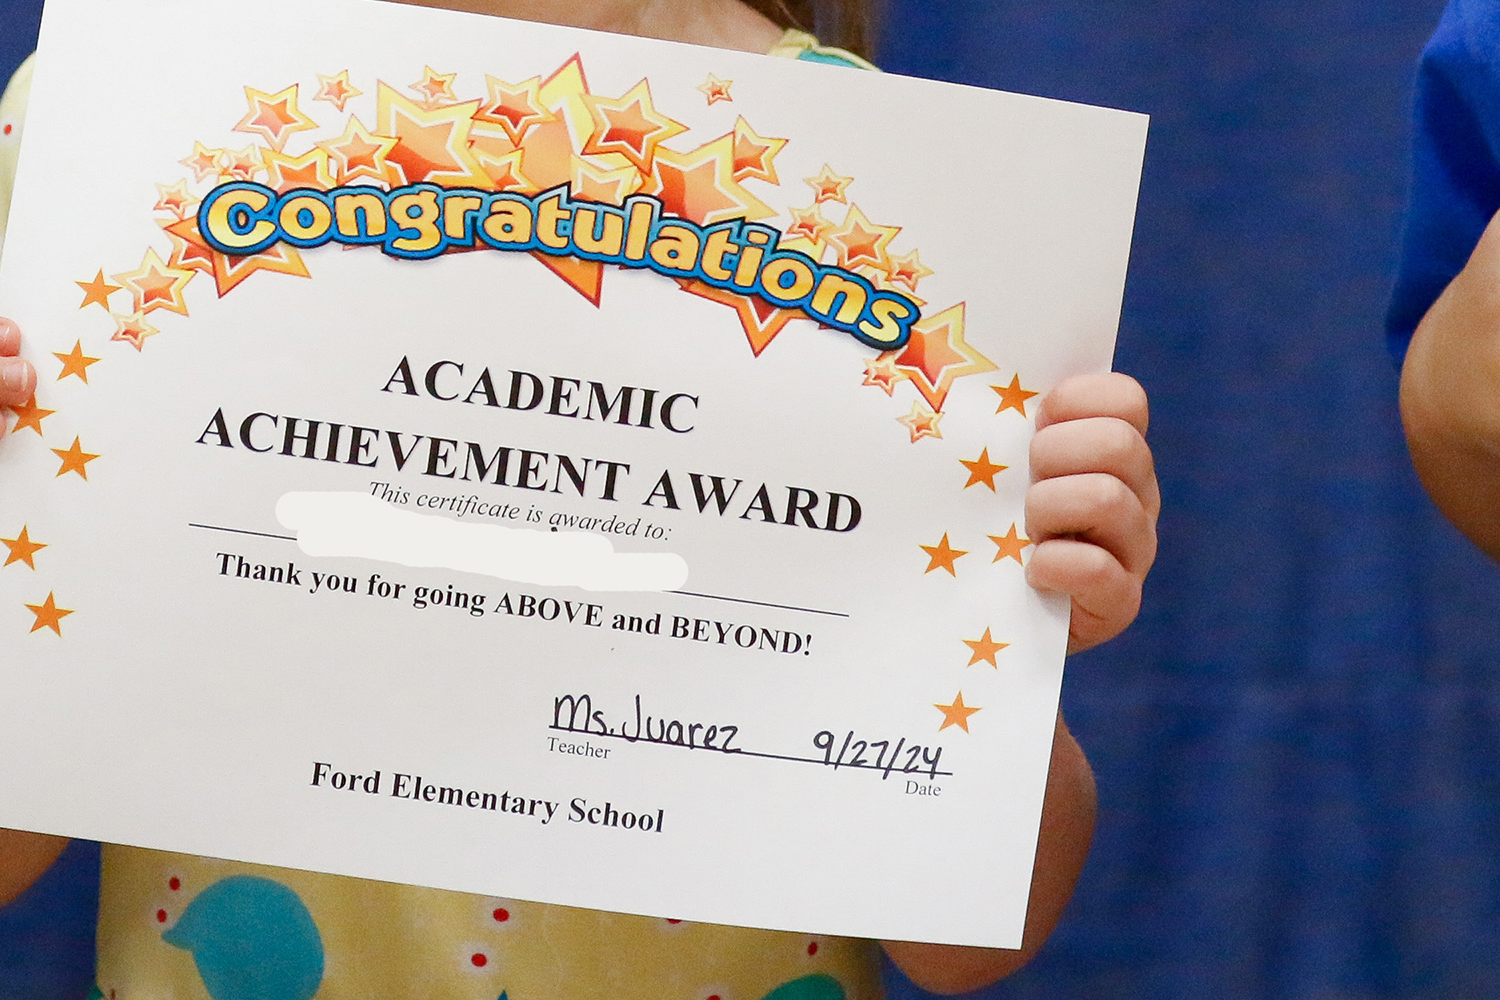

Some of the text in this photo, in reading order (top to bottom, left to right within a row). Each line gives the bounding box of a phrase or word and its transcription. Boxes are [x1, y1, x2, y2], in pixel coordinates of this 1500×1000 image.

[199, 182, 920, 350] Congratulations
[380, 355, 700, 434] ACADEMIC
[195, 407, 862, 533] ACHIEVEMENT AWARD
[370, 481, 673, 541] This certificate is awarded to:
[216, 552, 813, 656] Thank you for going ABOVE and BEYOND!
[547, 737, 612, 760] Teacher
[813, 730, 943, 780] 9/27/24
[310, 762, 665, 833] Ford Elementary School
[905, 780, 942, 797] Date
